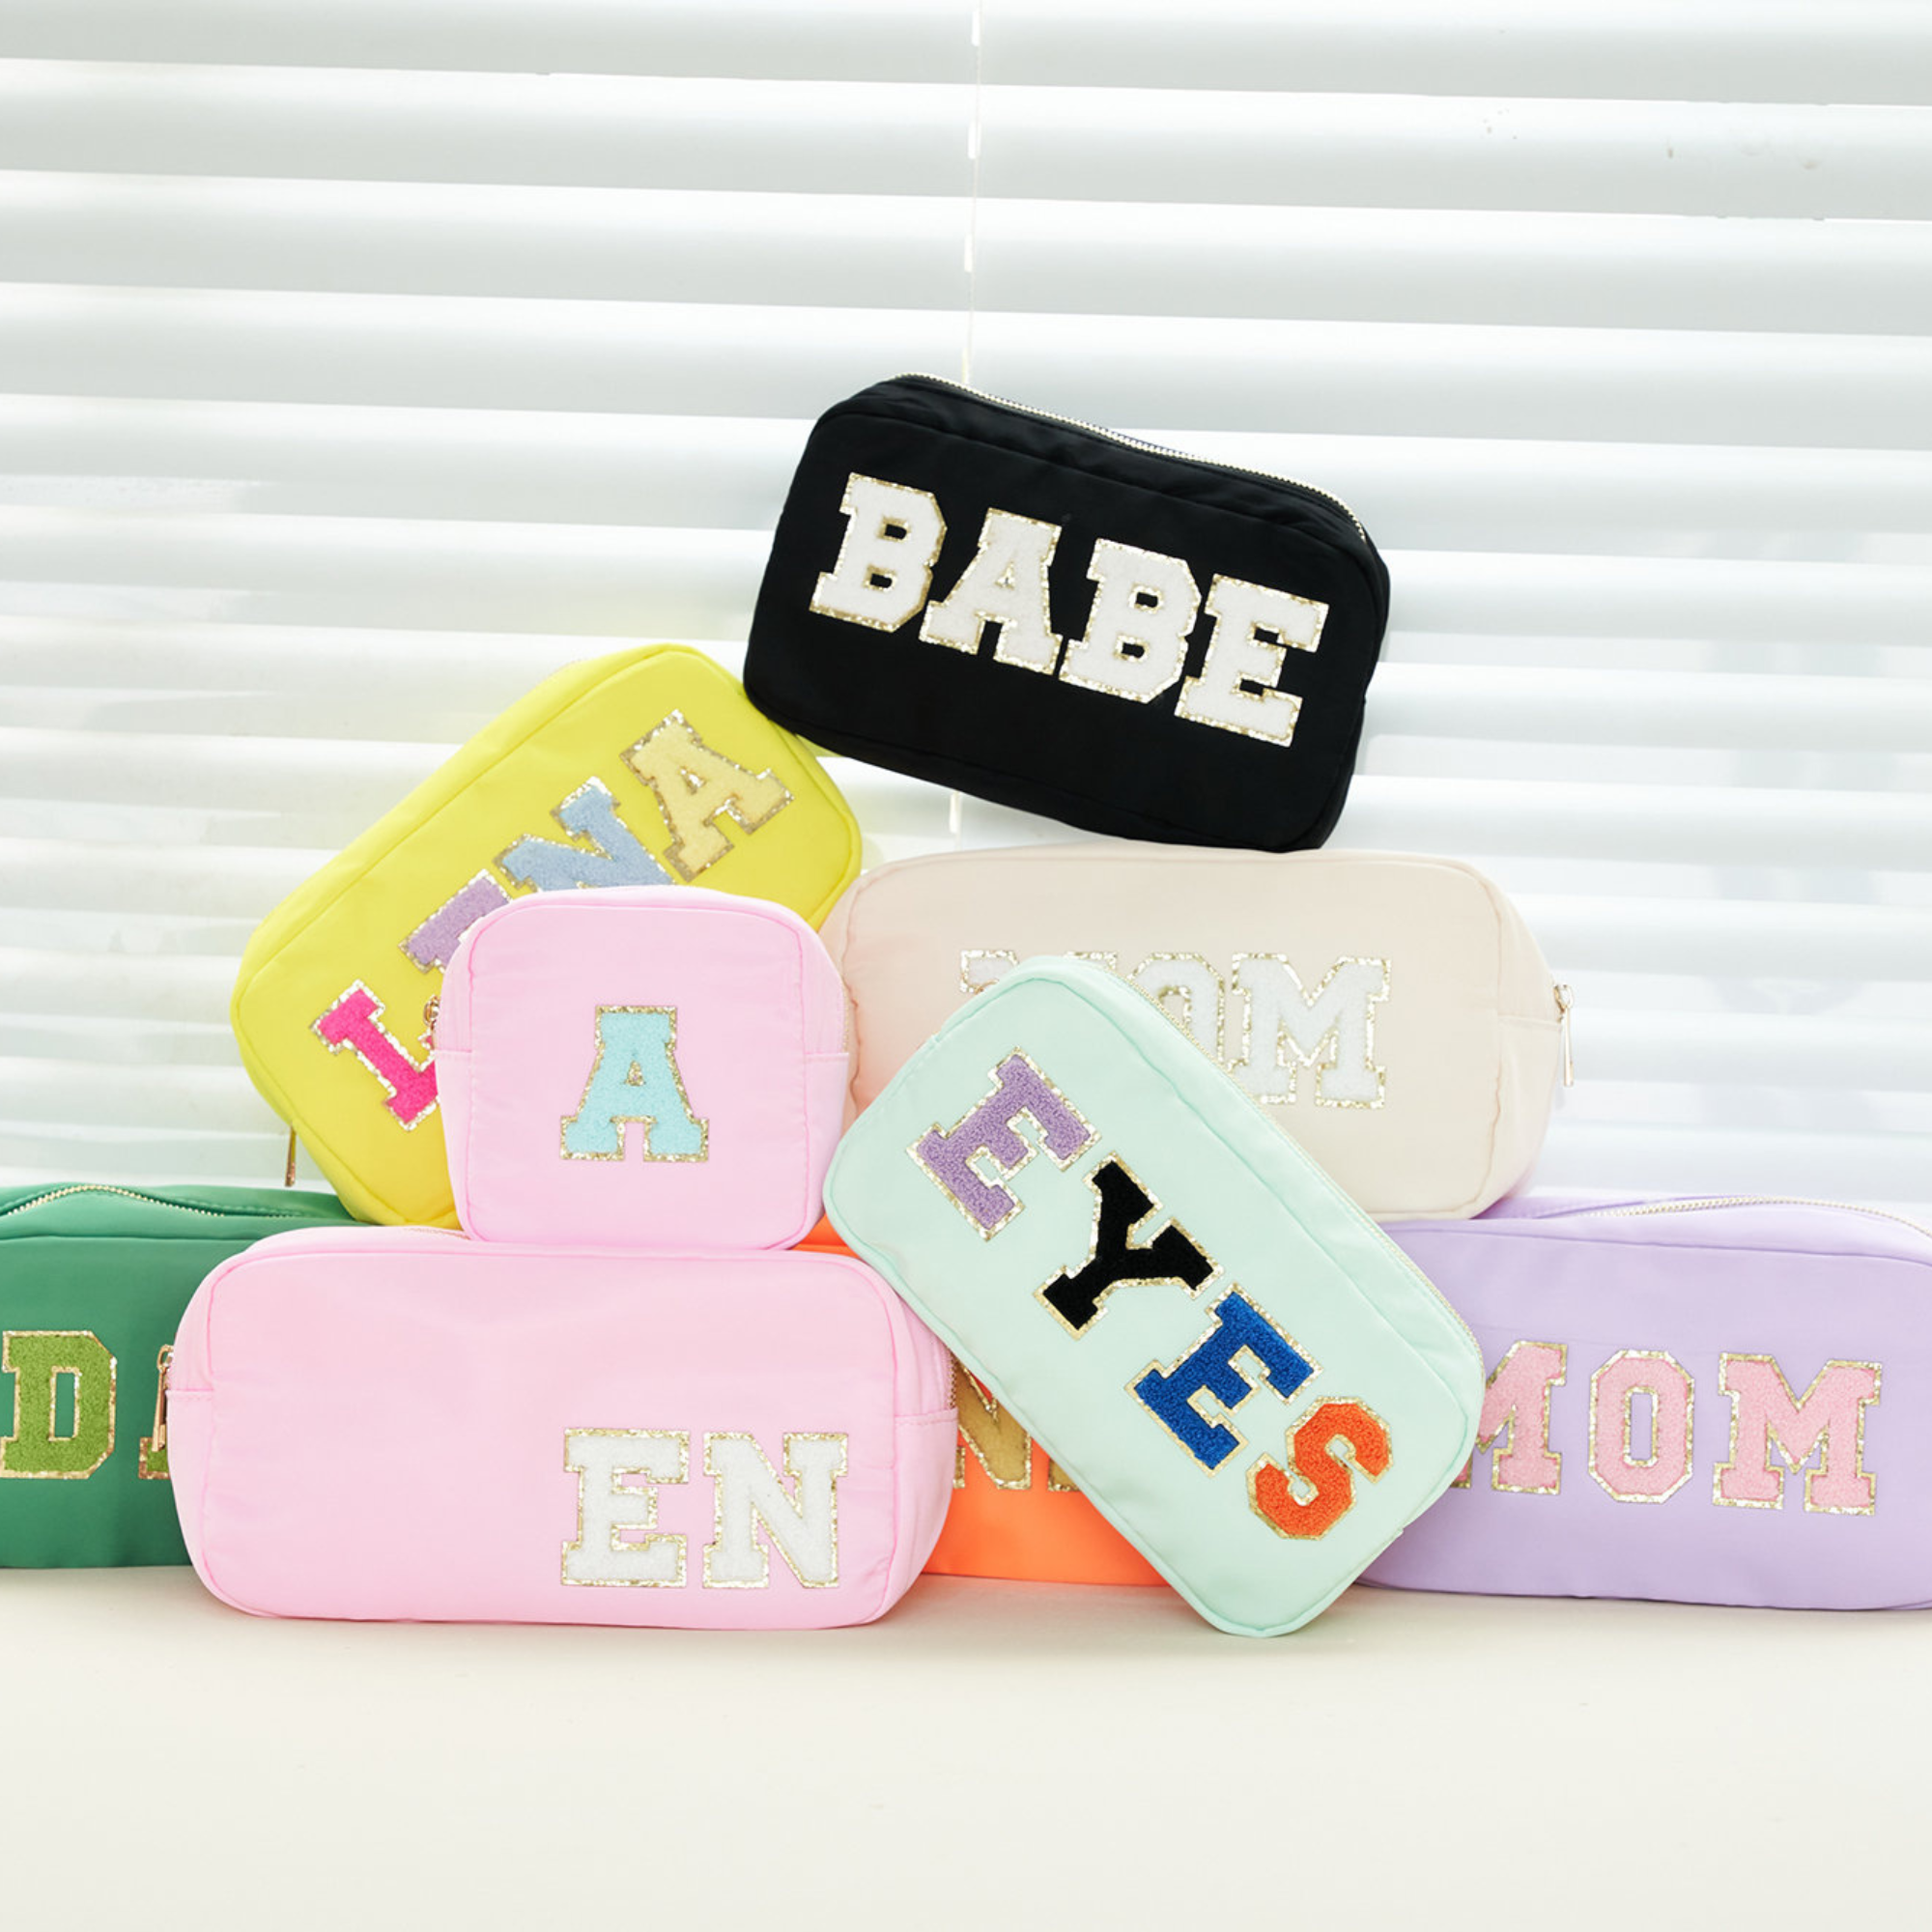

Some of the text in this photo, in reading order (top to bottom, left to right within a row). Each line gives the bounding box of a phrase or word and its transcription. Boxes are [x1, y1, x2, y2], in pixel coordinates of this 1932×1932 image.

[810, 472, 1330, 747] BABE
[310, 708, 796, 1132] LNA
[559, 1006, 709, 1161] A
[906, 1045, 1394, 1541] EYES
[560, 1428, 849, 1589] EN
